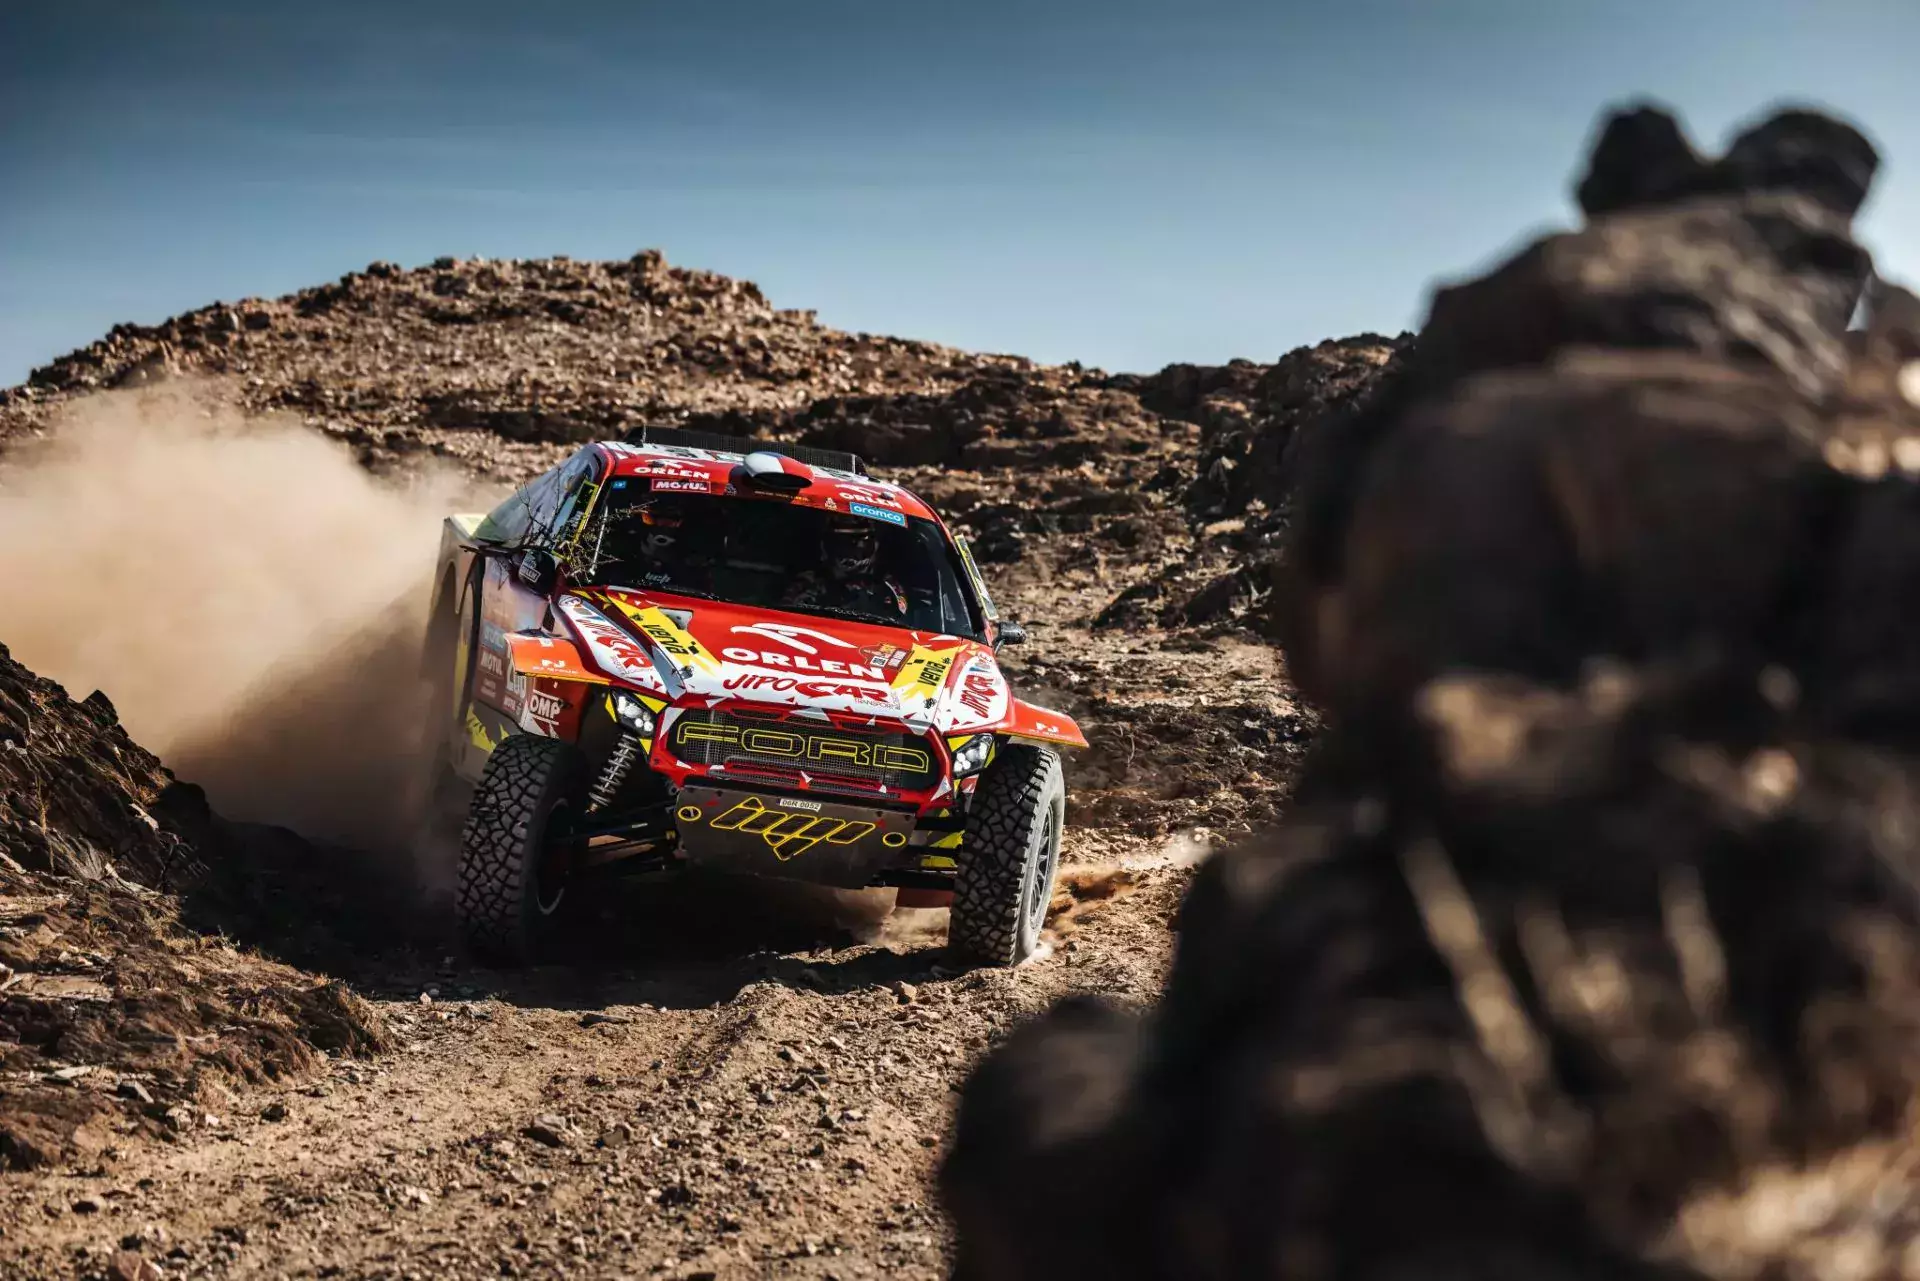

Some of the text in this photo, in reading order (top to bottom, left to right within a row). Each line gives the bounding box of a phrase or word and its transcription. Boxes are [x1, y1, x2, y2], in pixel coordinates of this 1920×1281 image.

[633, 466, 711, 480] ORLEN
[656, 481, 708, 491] MOTUL
[722, 647, 886, 681] ORLEN
[529, 694, 561, 719] OMP
[677, 721, 929, 774] FORD
